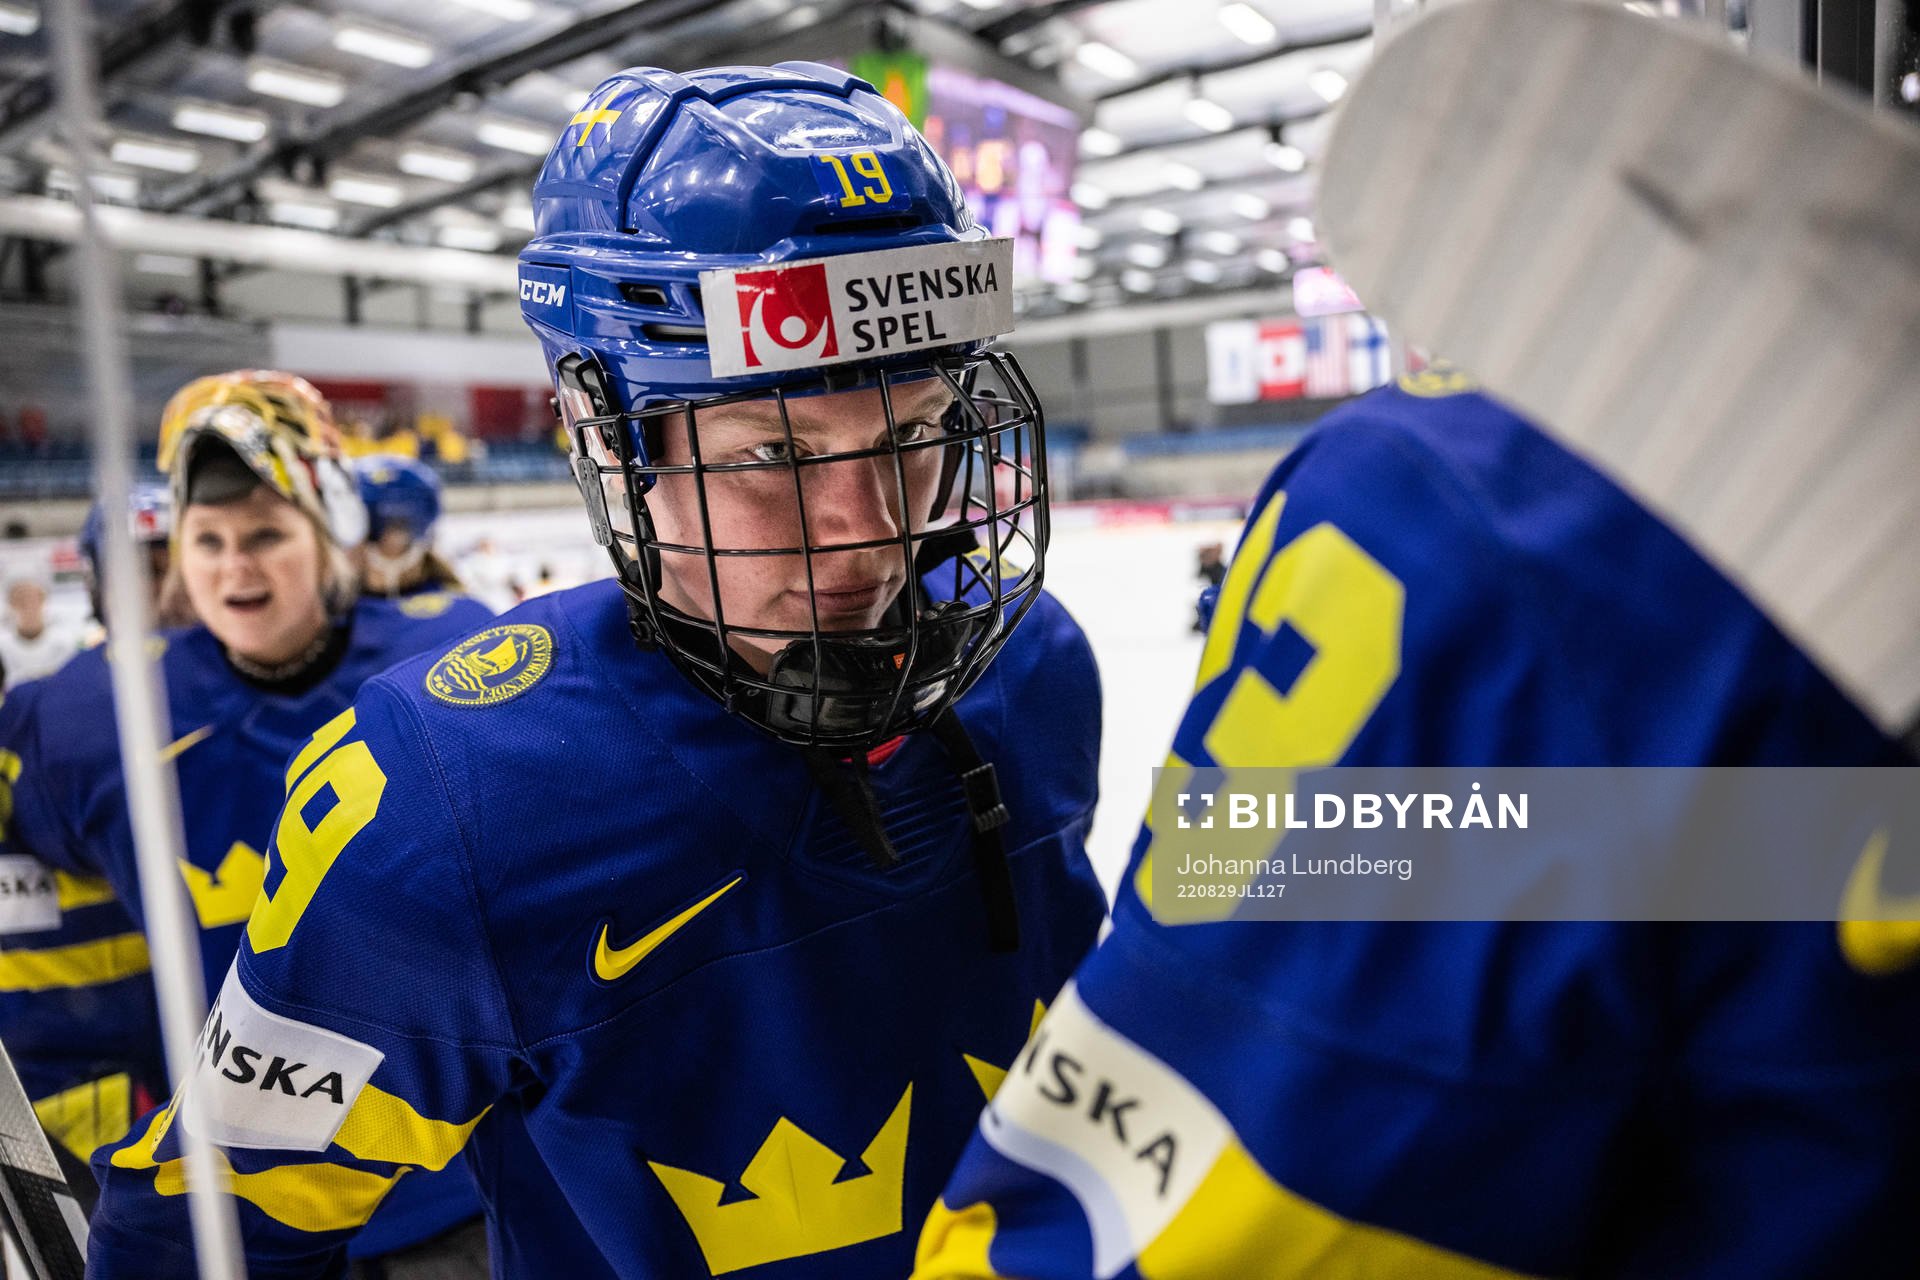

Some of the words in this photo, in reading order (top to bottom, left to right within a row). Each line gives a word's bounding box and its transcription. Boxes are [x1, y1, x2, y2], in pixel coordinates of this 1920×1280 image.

[820, 151, 893, 208] 19
[520, 279, 566, 307] CCM
[845, 263, 998, 313] SVENSKA
[852, 310, 947, 353] SPEL
[206, 993, 344, 1105] NSKA
